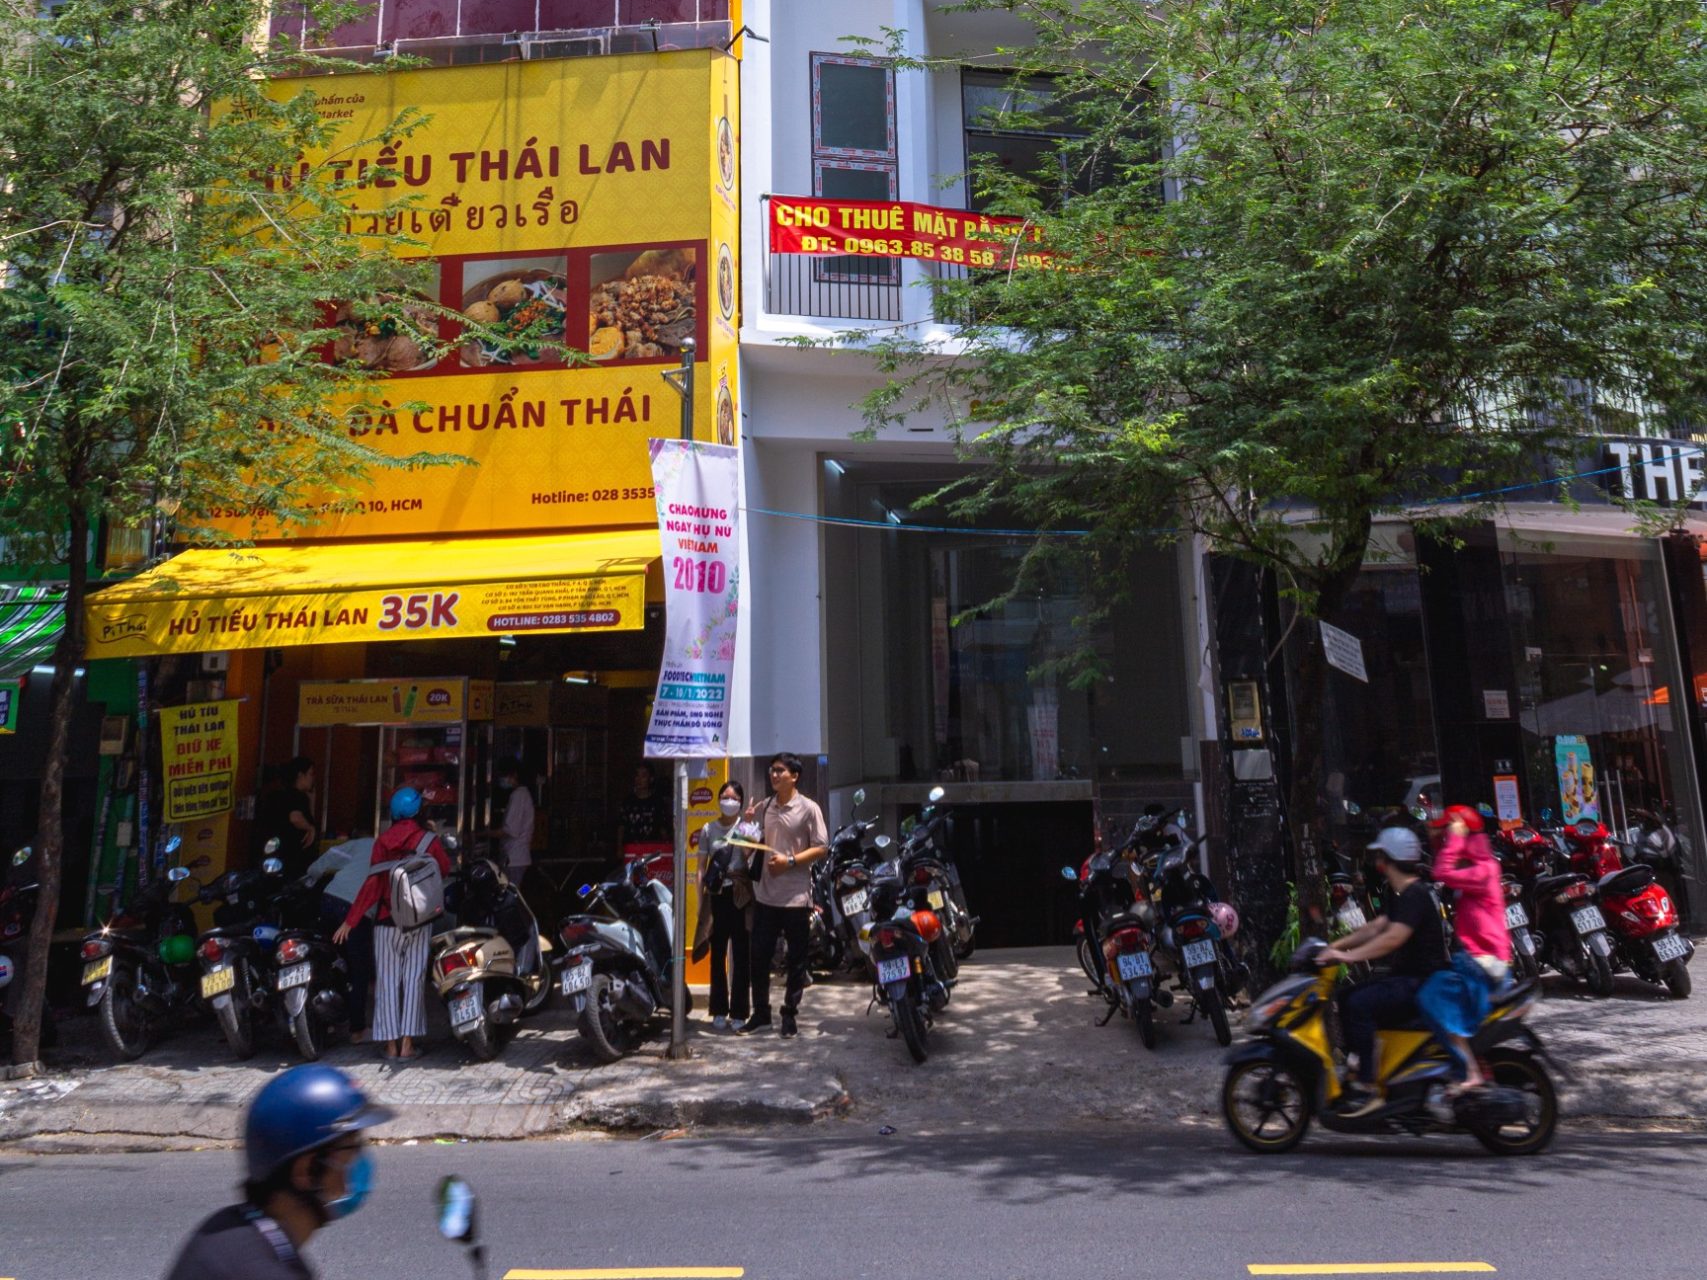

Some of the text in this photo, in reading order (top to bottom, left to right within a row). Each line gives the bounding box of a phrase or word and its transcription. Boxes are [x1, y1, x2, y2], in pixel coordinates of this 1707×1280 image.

[327, 140, 432, 190] TIẾU
[449, 136, 560, 183] THÁI
[579, 138, 671, 175] LAN
[776, 205, 830, 229] CHO
[838, 206, 904, 231] THUÊ
[914, 210, 958, 242] MẶT
[801, 236, 837, 253] ĐT:
[844, 237, 935, 258] 0963.85
[940, 247, 965, 263] 38
[969, 249, 995, 267] 58
[412, 386, 545, 434] CHUẨN
[560, 386, 650, 426] THÁI
[369, 500, 388, 513] 10,
[391, 498, 423, 511] HCM
[531, 487, 655, 505] Hotline: 028 3535
[673, 556, 726, 595] 2010
[168, 593, 459, 636] HỦ TIẾU THÁI LAN 35K
[494, 616, 541, 627] HOTLINE:
[541, 615, 567, 625] 0283
[306, 695, 323, 705] TRÀ
[347, 694, 368, 704] THÁI
[370, 694, 388, 703] LAN
[429, 693, 448, 703] 20K
